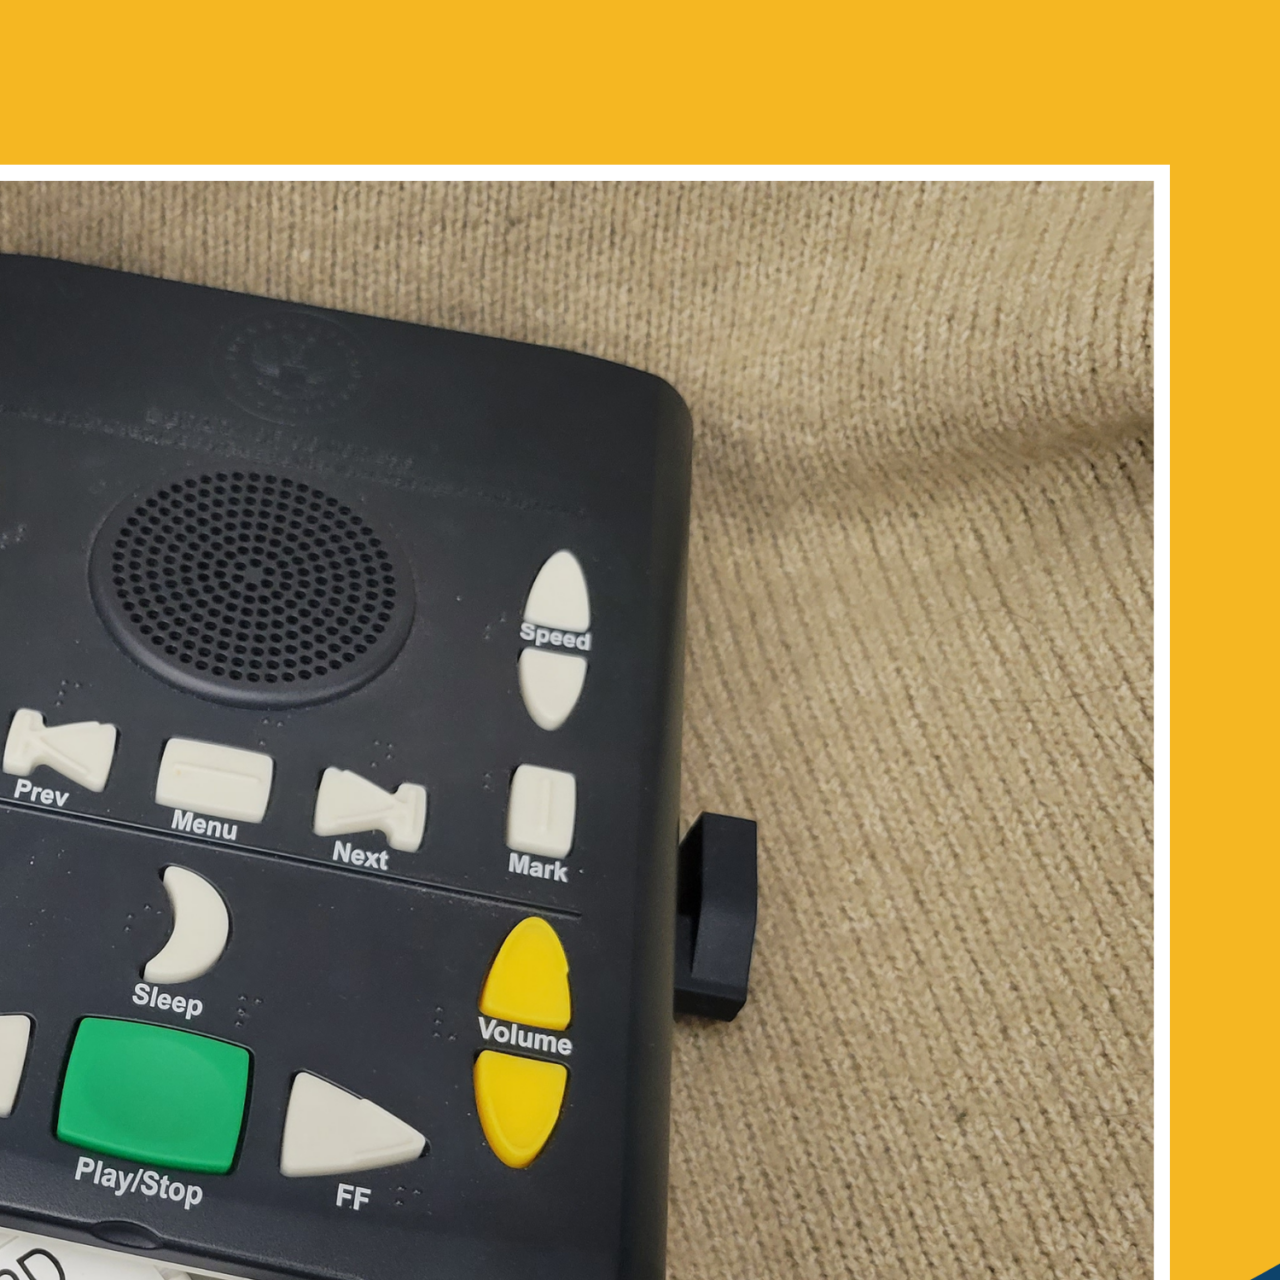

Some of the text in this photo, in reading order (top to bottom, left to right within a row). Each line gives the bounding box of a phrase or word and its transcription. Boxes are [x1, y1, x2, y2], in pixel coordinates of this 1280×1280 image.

[520, 622, 591, 650] Speed
[14, 778, 69, 807] Prev
[171, 810, 238, 840] Menu
[333, 841, 389, 871] Next
[509, 853, 568, 883] Mark
[132, 984, 204, 1017] Sleep
[478, 1017, 573, 1054] Volume
[75, 1157, 203, 1209] Play/Stop
[336, 1184, 372, 1210] FF
